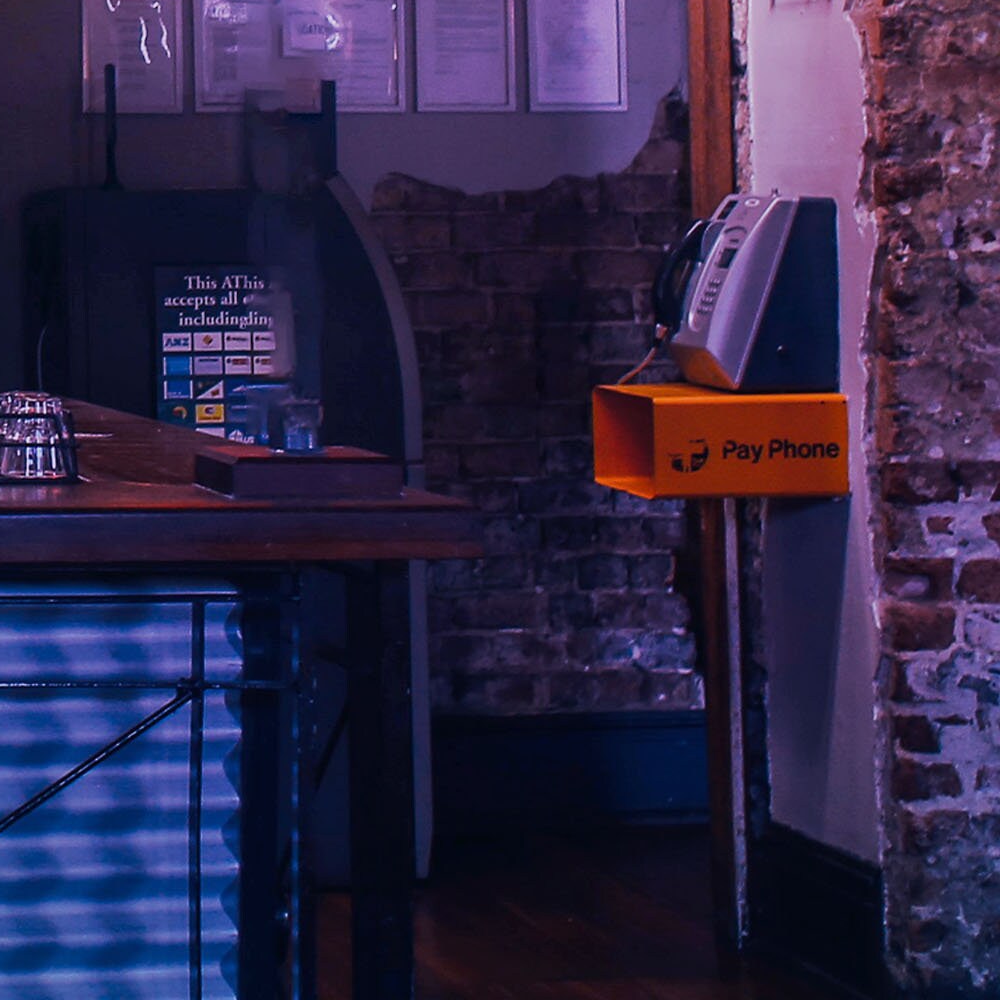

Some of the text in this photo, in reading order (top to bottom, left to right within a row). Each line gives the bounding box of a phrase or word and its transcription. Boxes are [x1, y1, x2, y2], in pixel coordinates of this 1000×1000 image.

[184, 275, 217, 290] This
[164, 296, 216, 310] accepts
[220, 291, 238, 306] all
[722, 439, 840, 463] Pay Phone
